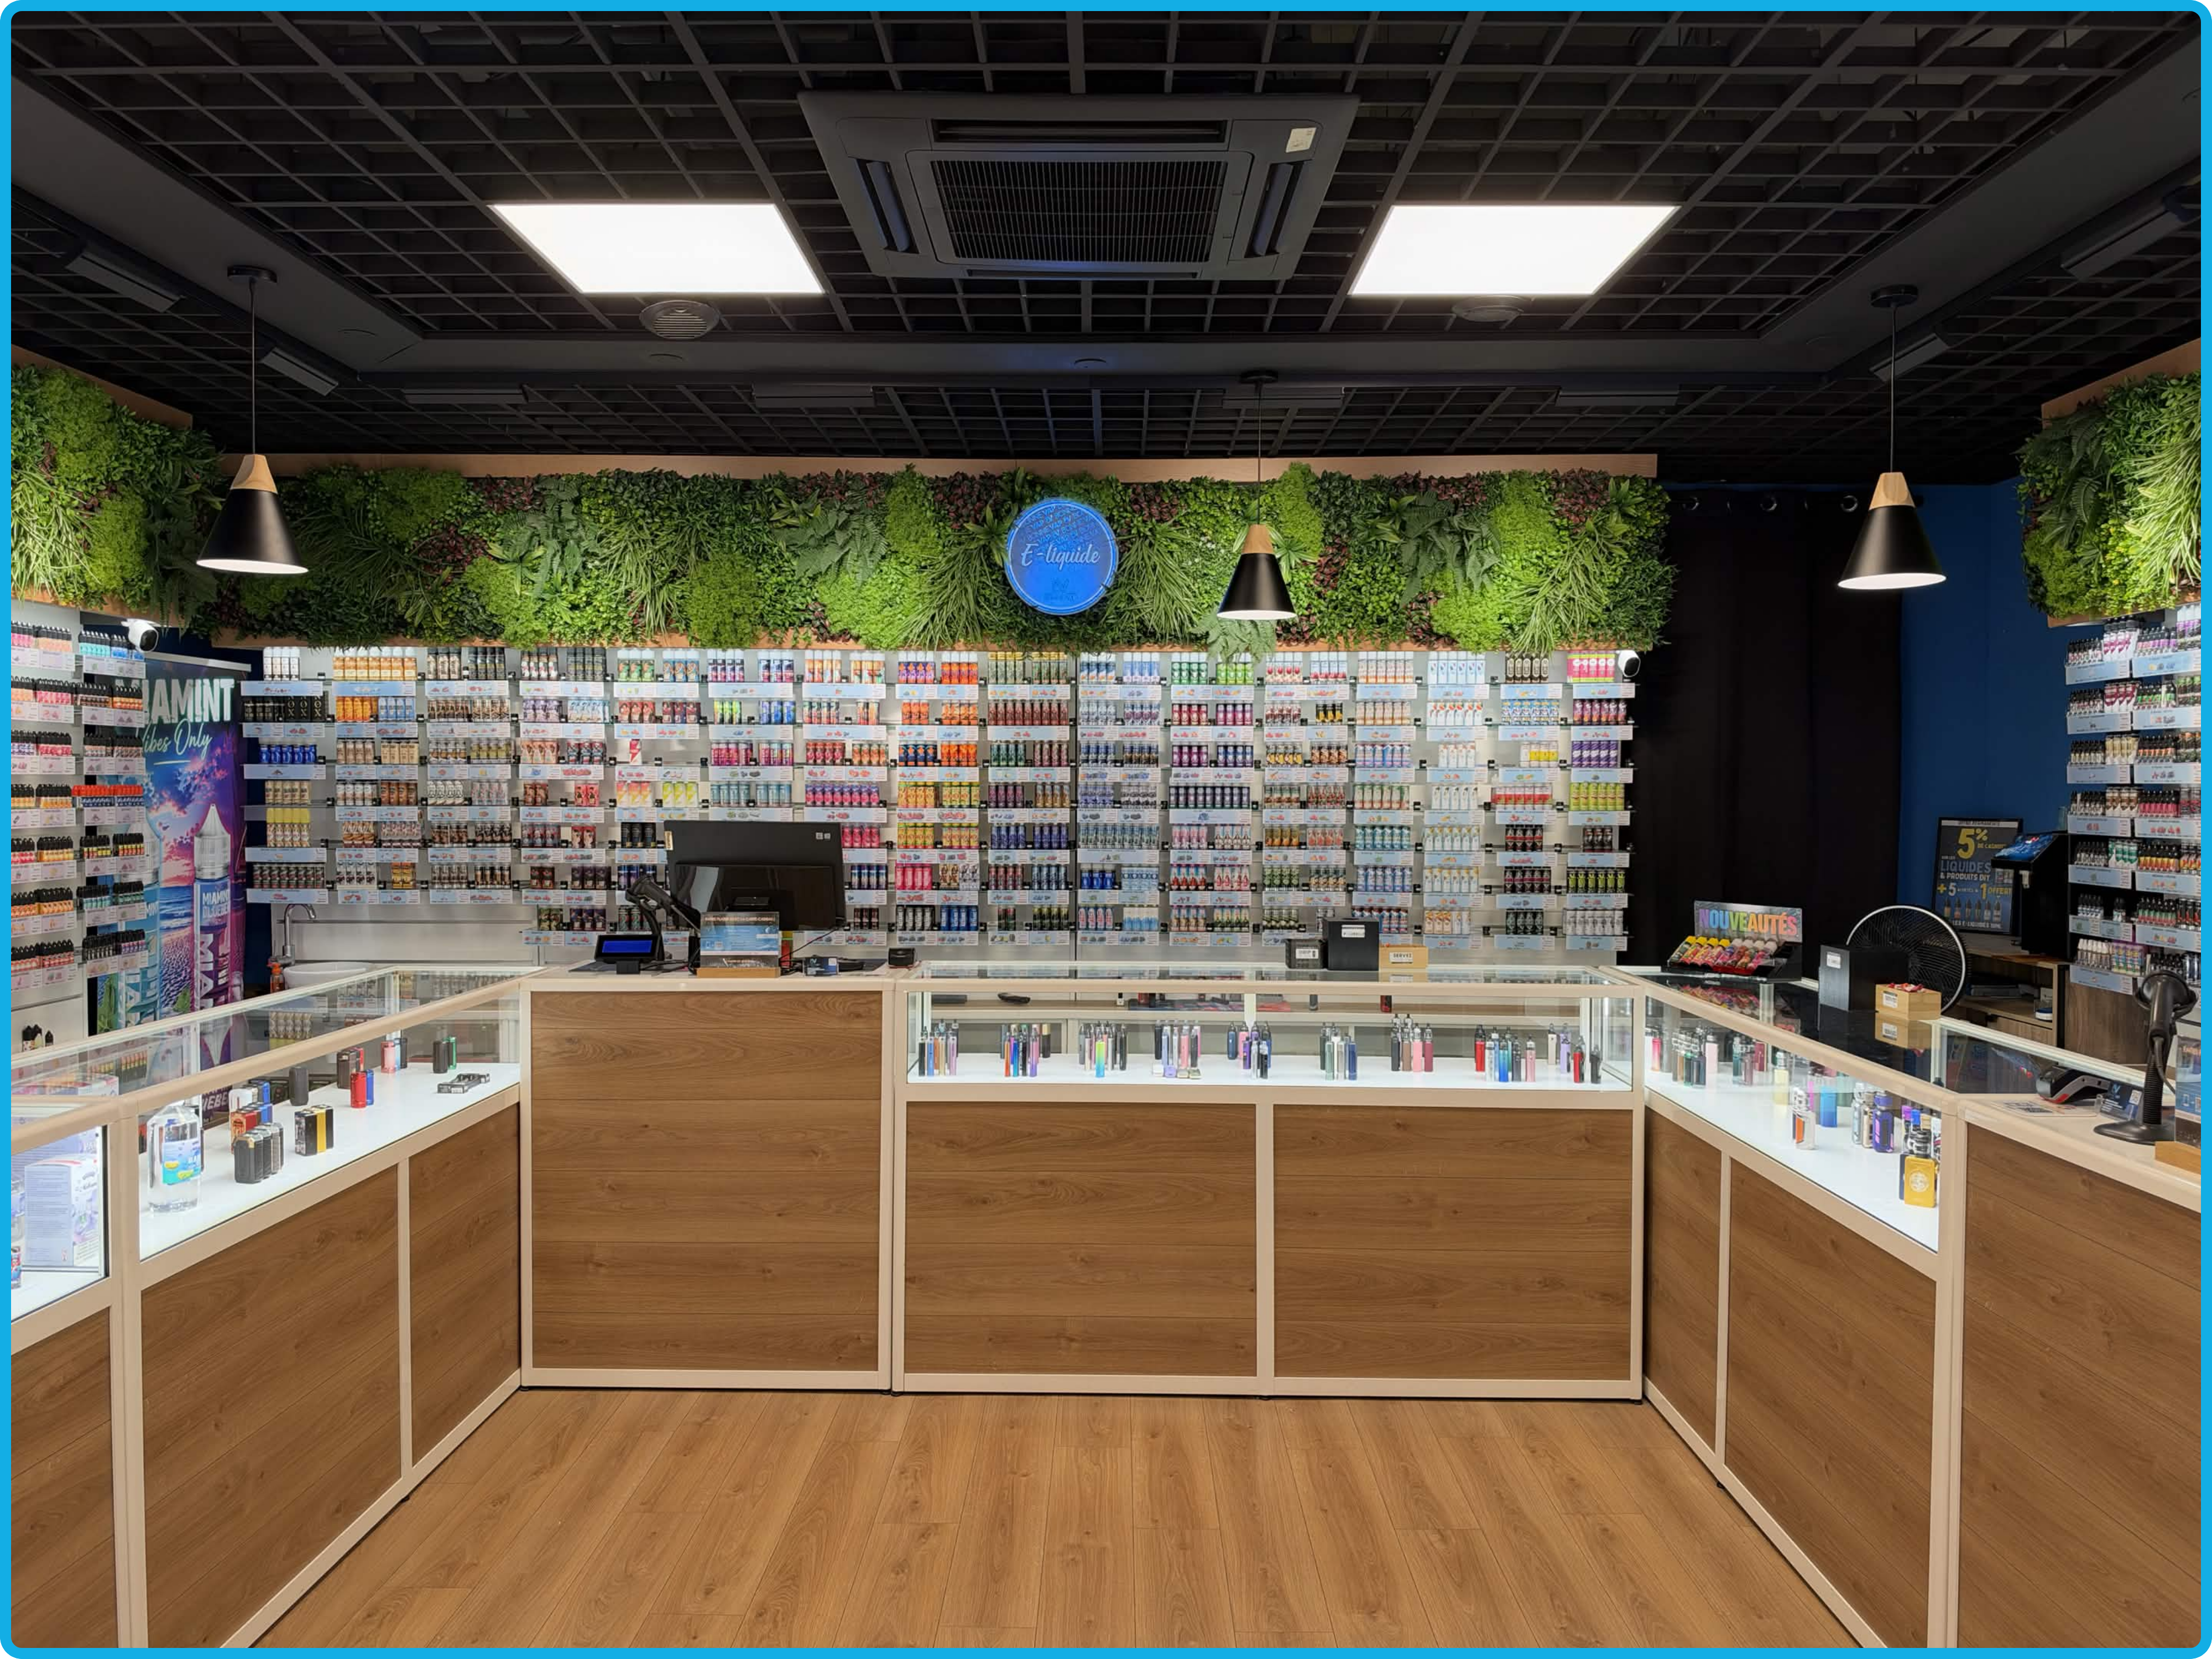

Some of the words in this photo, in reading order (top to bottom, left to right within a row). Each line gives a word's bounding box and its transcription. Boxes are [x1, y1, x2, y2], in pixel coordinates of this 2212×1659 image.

[1021, 543, 1100, 571] E-liquide
[114, 678, 235, 724] IAMINT
[174, 718, 213, 760] Only
[1940, 860, 1991, 874] LIQUIDES
[1946, 872, 1979, 881] PRODUITS
[1948, 882, 1957, 896] 5
[1980, 883, 1987, 900] 1
[1988, 886, 2012, 895] OFFERT
[1699, 909, 1798, 935] NOUVEAUTÉS
